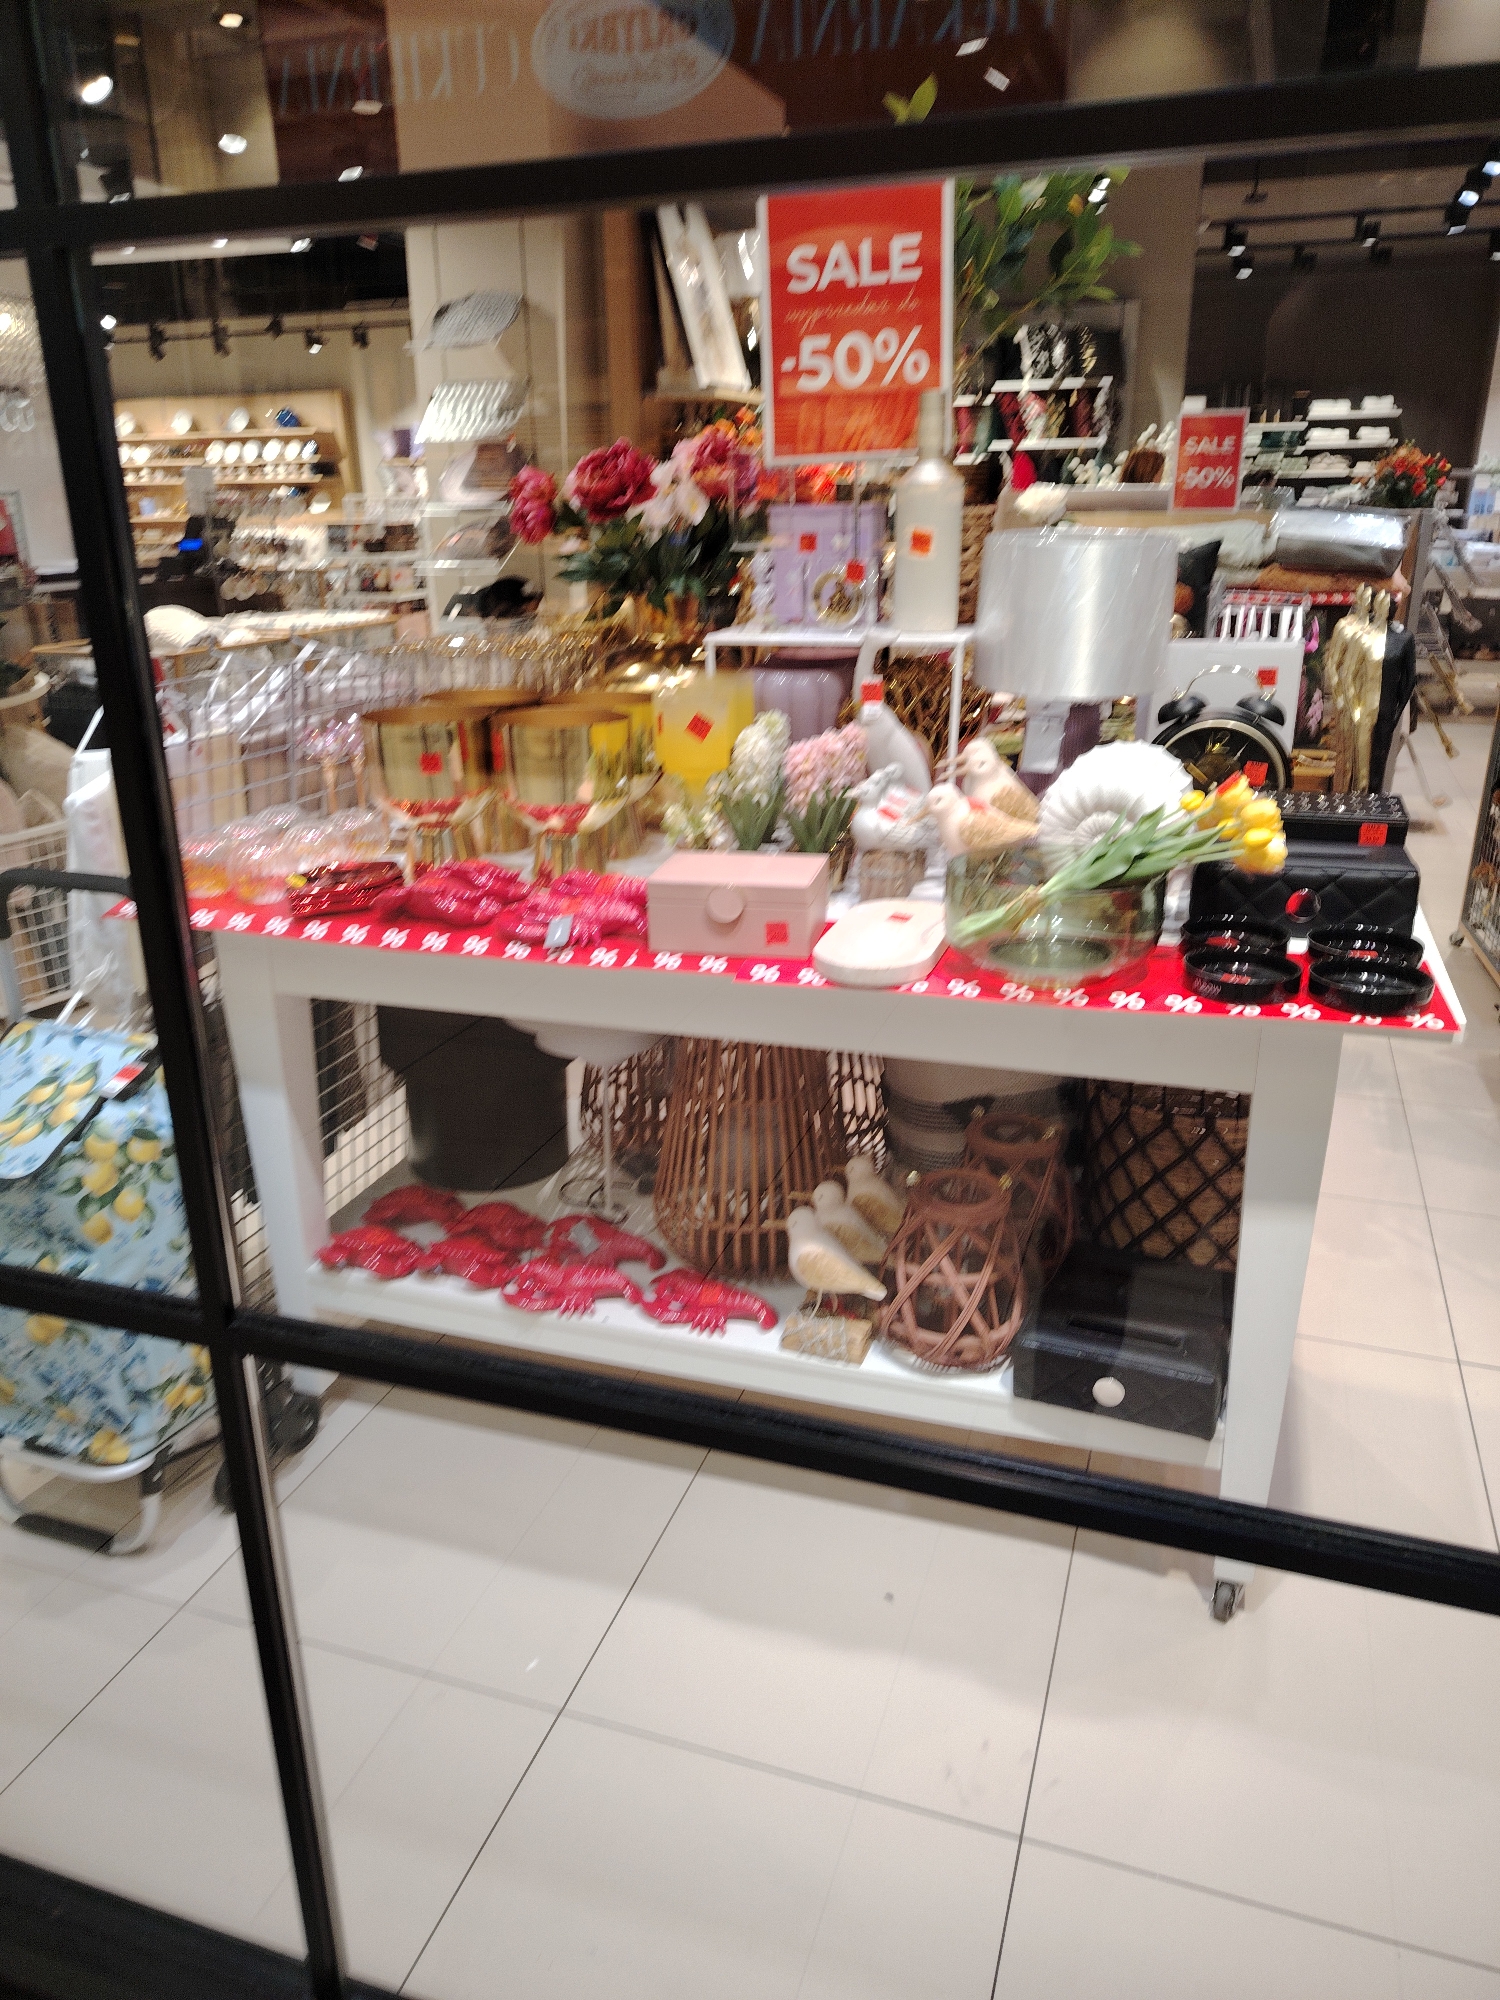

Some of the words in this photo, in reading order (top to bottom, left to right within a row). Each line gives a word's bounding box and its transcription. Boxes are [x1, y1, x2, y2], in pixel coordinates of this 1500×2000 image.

[786, 231, 923, 295] SALE
[780, 324, 931, 394] -50%
[1183, 435, 1237, 457] SALE
